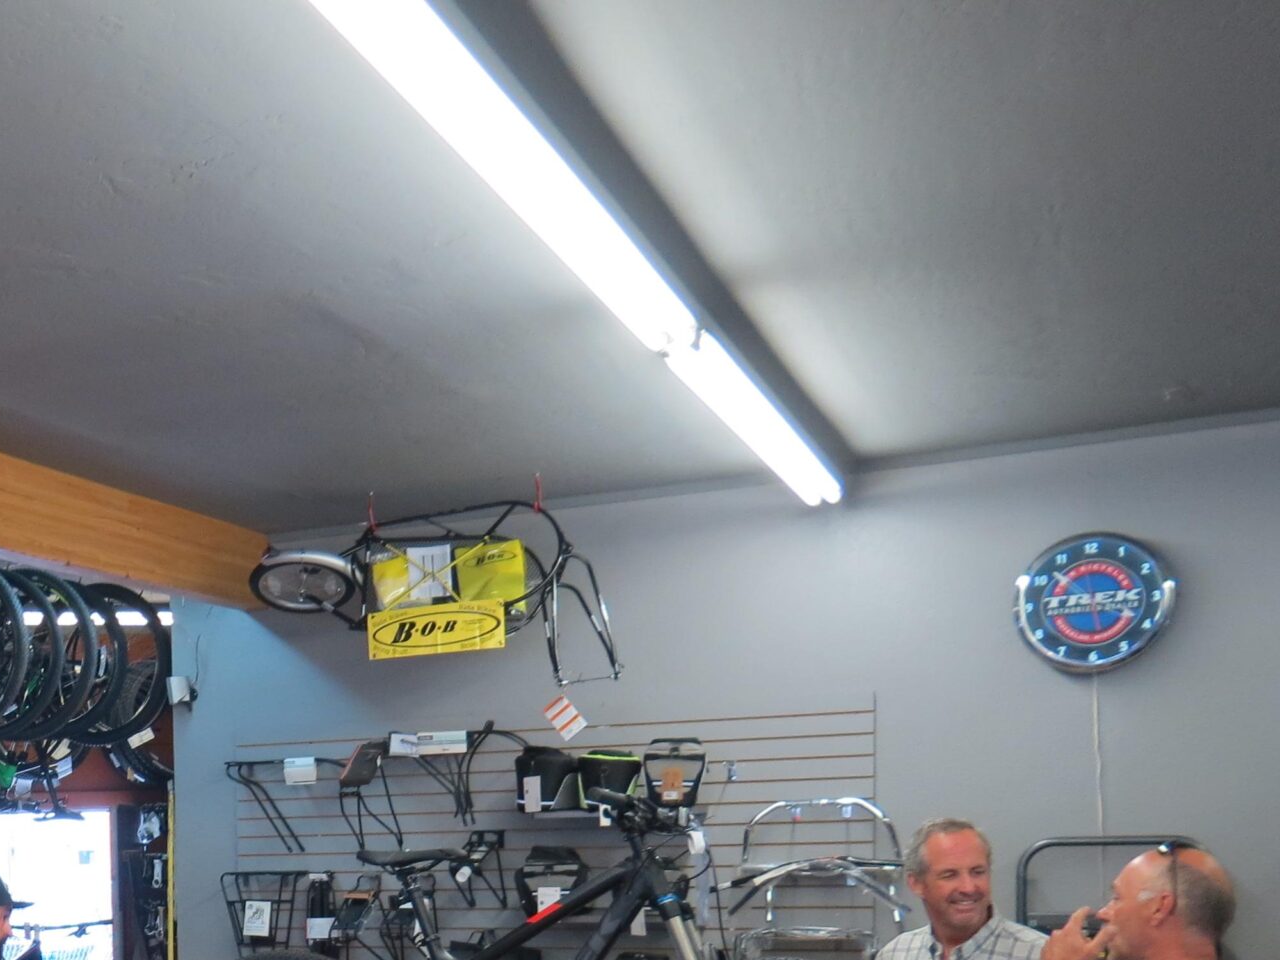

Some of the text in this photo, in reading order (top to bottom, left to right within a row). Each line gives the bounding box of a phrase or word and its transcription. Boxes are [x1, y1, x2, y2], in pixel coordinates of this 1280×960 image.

[1083, 542, 1099, 554] 12
[1118, 546, 1126, 557] 1
[1055, 554, 1068, 565] 11
[1140, 563, 1152, 574] 2
[1034, 575, 1048, 586] 10
[1043, 588, 1143, 608] TREK
[1151, 590, 1162, 601] 3
[1025, 603, 1033, 613] 9
[1141, 618, 1152, 629] 4
[1035, 629, 1044, 639] 8
[1057, 646, 1067, 656] 7
[1119, 641, 1129, 652] 5
[1088, 651, 1098, 662] 6
